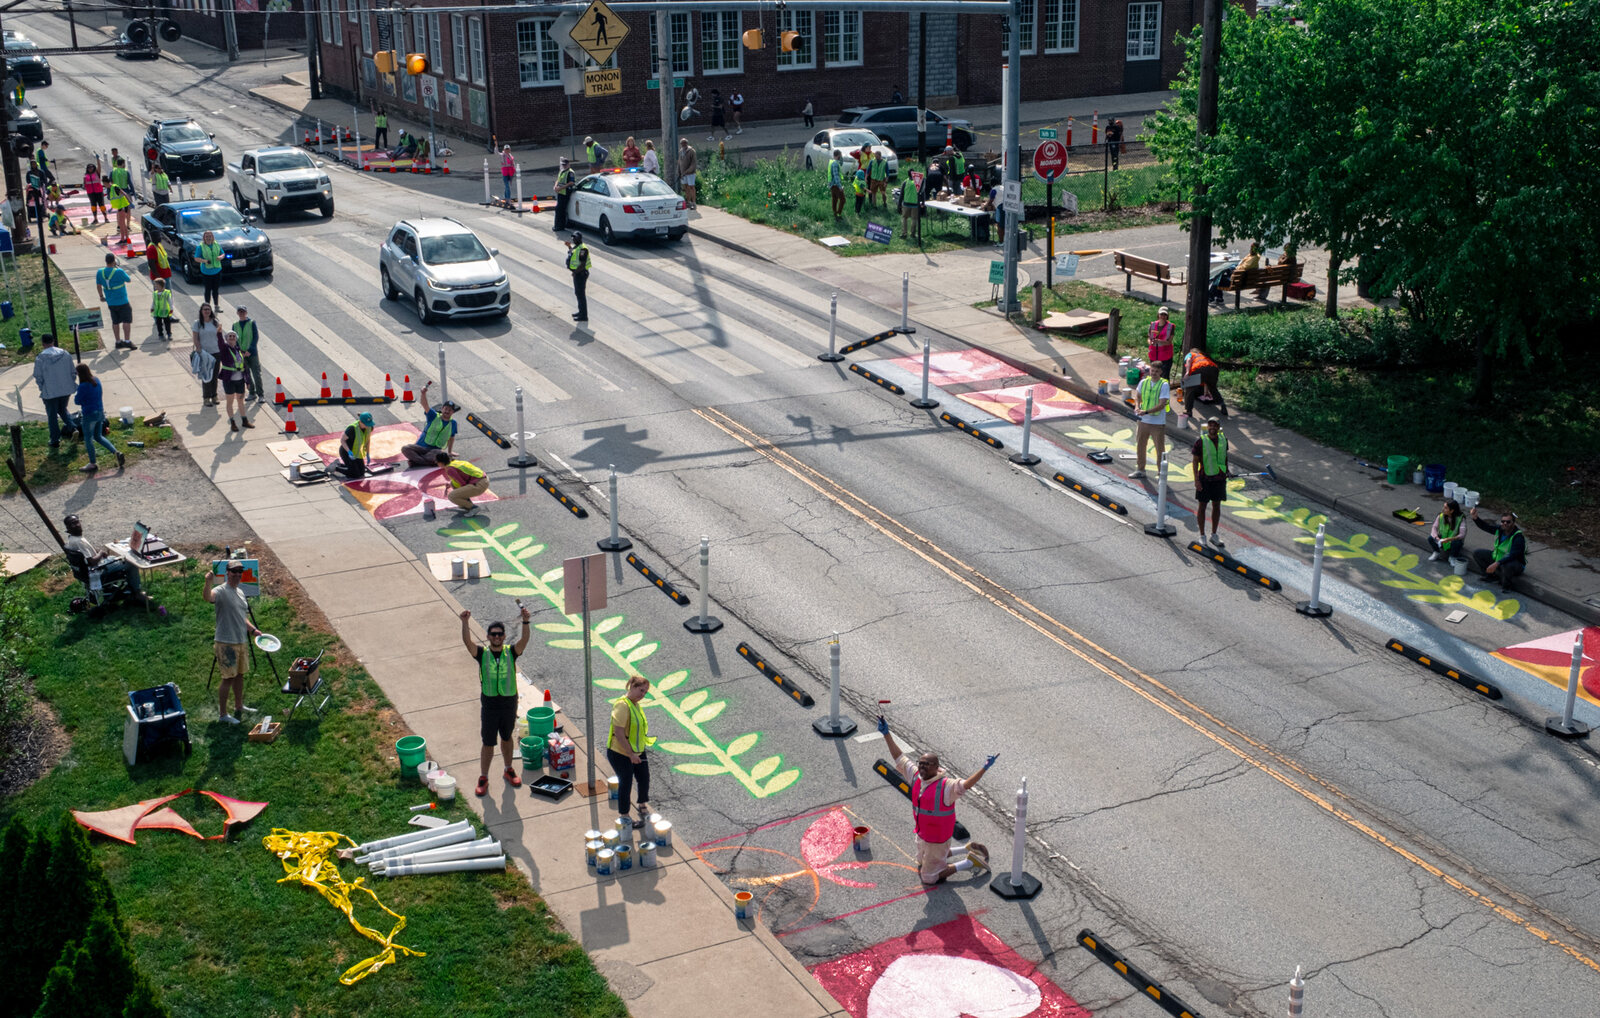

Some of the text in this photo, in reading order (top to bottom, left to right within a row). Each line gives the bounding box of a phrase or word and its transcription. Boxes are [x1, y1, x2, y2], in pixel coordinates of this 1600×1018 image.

[586, 72, 620, 83] MONON
[591, 84, 616, 93] TRAIL
[868, 223, 883, 232] VOTE
